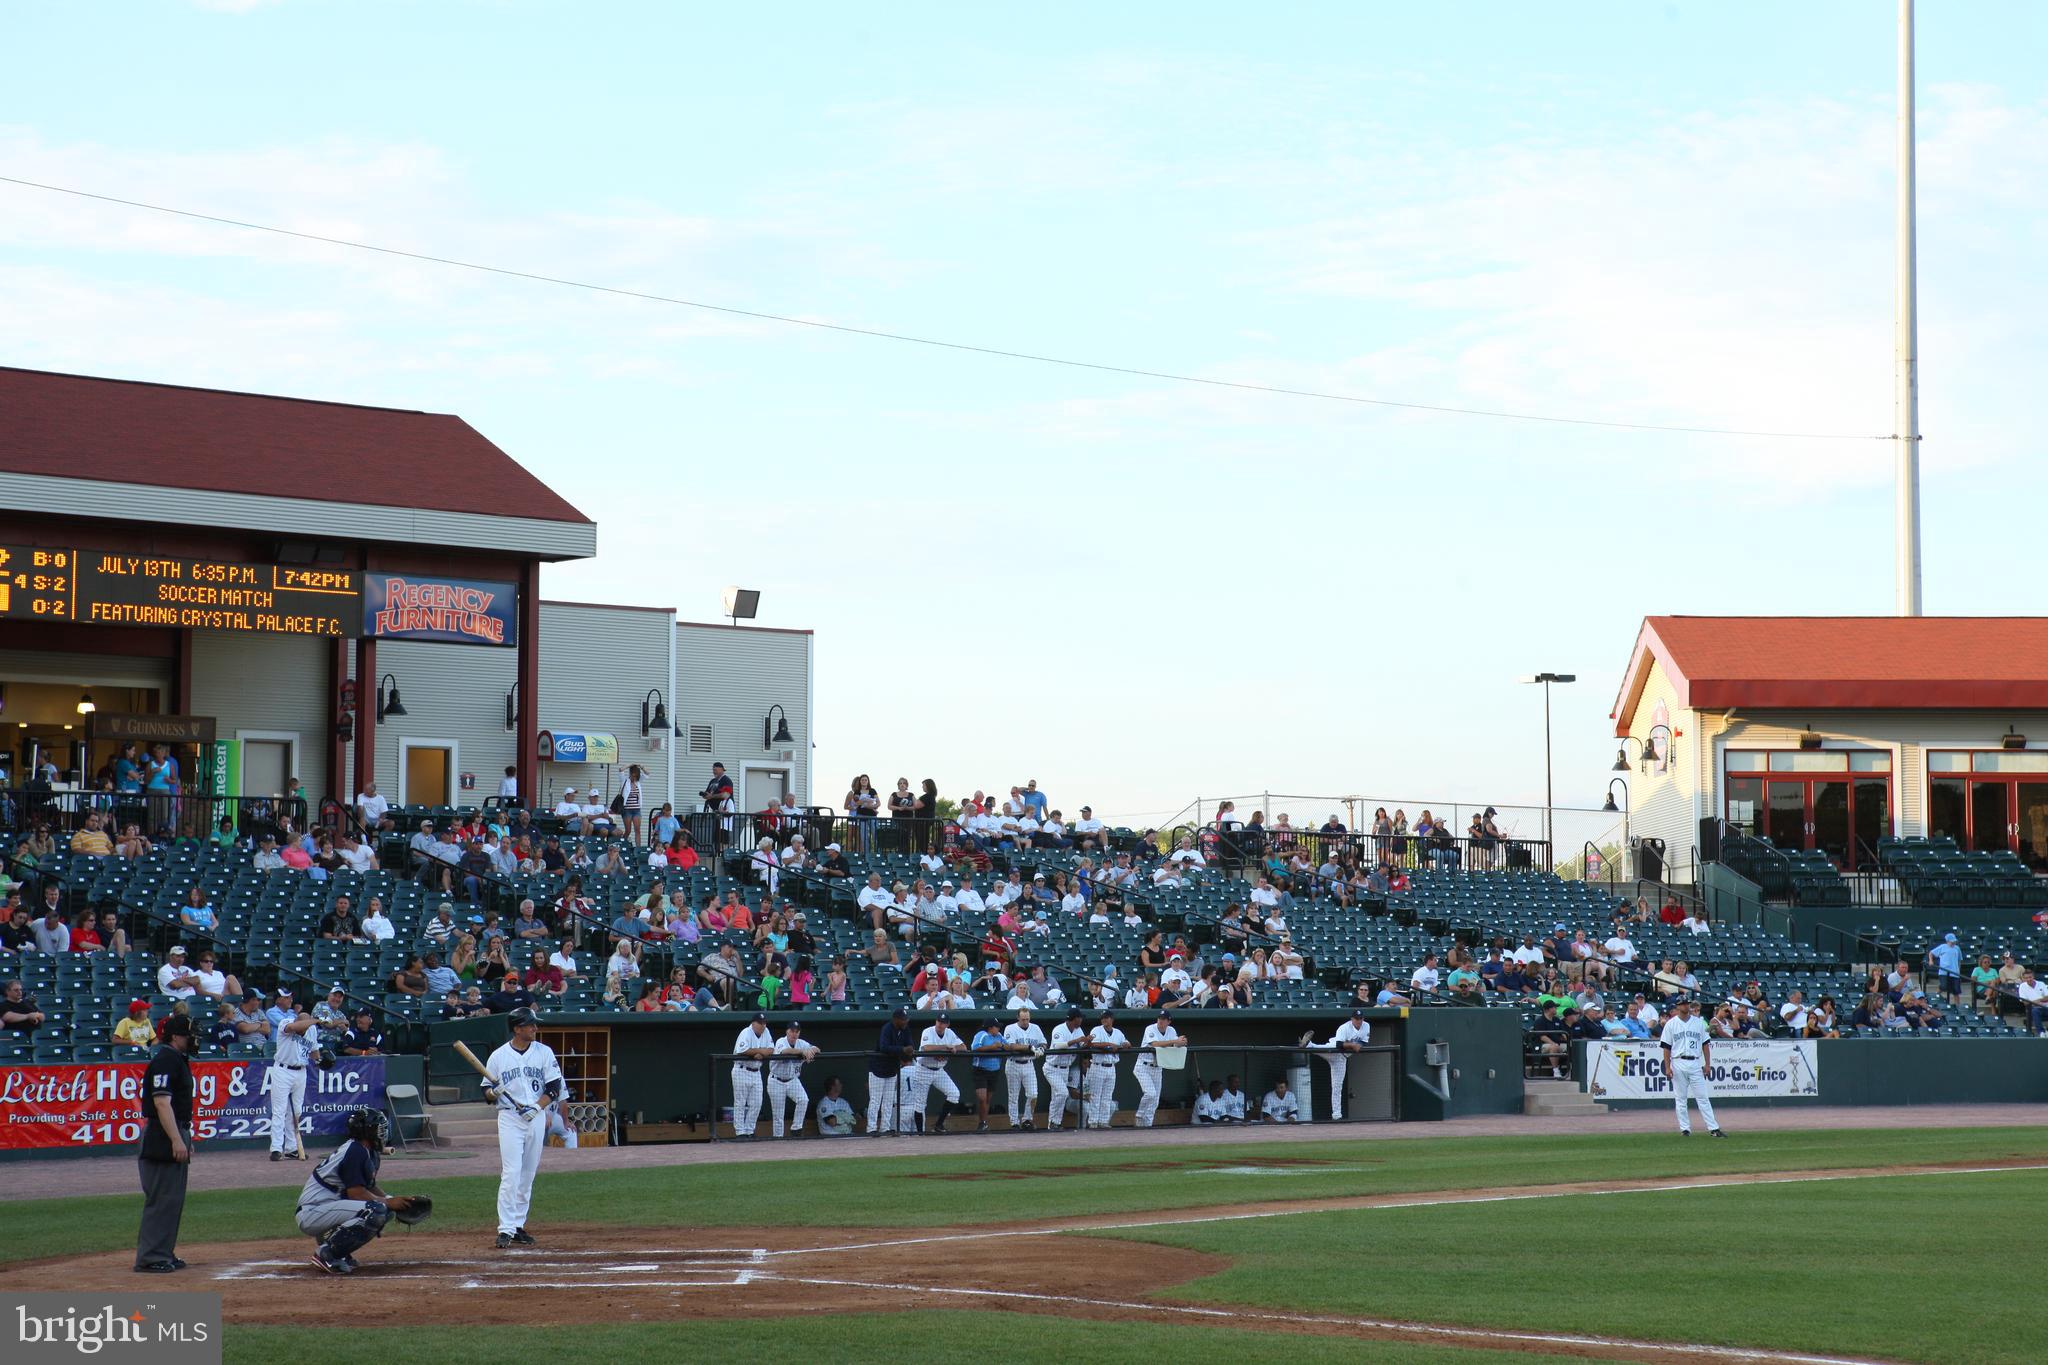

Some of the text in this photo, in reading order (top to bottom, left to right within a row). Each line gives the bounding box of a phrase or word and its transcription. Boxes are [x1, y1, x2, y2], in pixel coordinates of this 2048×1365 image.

[33, 551, 67, 568] B:0
[97, 556, 258, 584] JULY 13TH 6:35 P.M.
[14, 574, 27, 589] 4
[33, 575, 66, 592] S:2
[284, 570, 350, 589] 7:42PM
[158, 584, 273, 608] SOCCER MATCH
[385, 577, 494, 614] REGENCY
[91, 602, 343, 635] FEATURING CRYSTAL PALACE F.C.
[375, 607, 504, 642] FURNITURE
[127, 718, 185, 737] GUINNESS
[1640, 1041, 1658, 1049] Rentals
[1689, 1040, 1698, 1049] 21
[0, 1069, 91, 1104] Leitch
[153, 1074, 168, 1088] 51
[228, 1066, 249, 1097] &
[318, 1070, 369, 1093] Inc.
[531, 1079, 540, 1092] 6
[905, 1077, 912, 1091] 1
[9, 1113, 65, 1125] Providing
[69, 1114, 76, 1122] a
[80, 1110, 107, 1121] Safe
[110, 1109, 119, 1120] &
[197, 1105, 268, 1117] Environment
[312, 1103, 369, 1113] Customers
